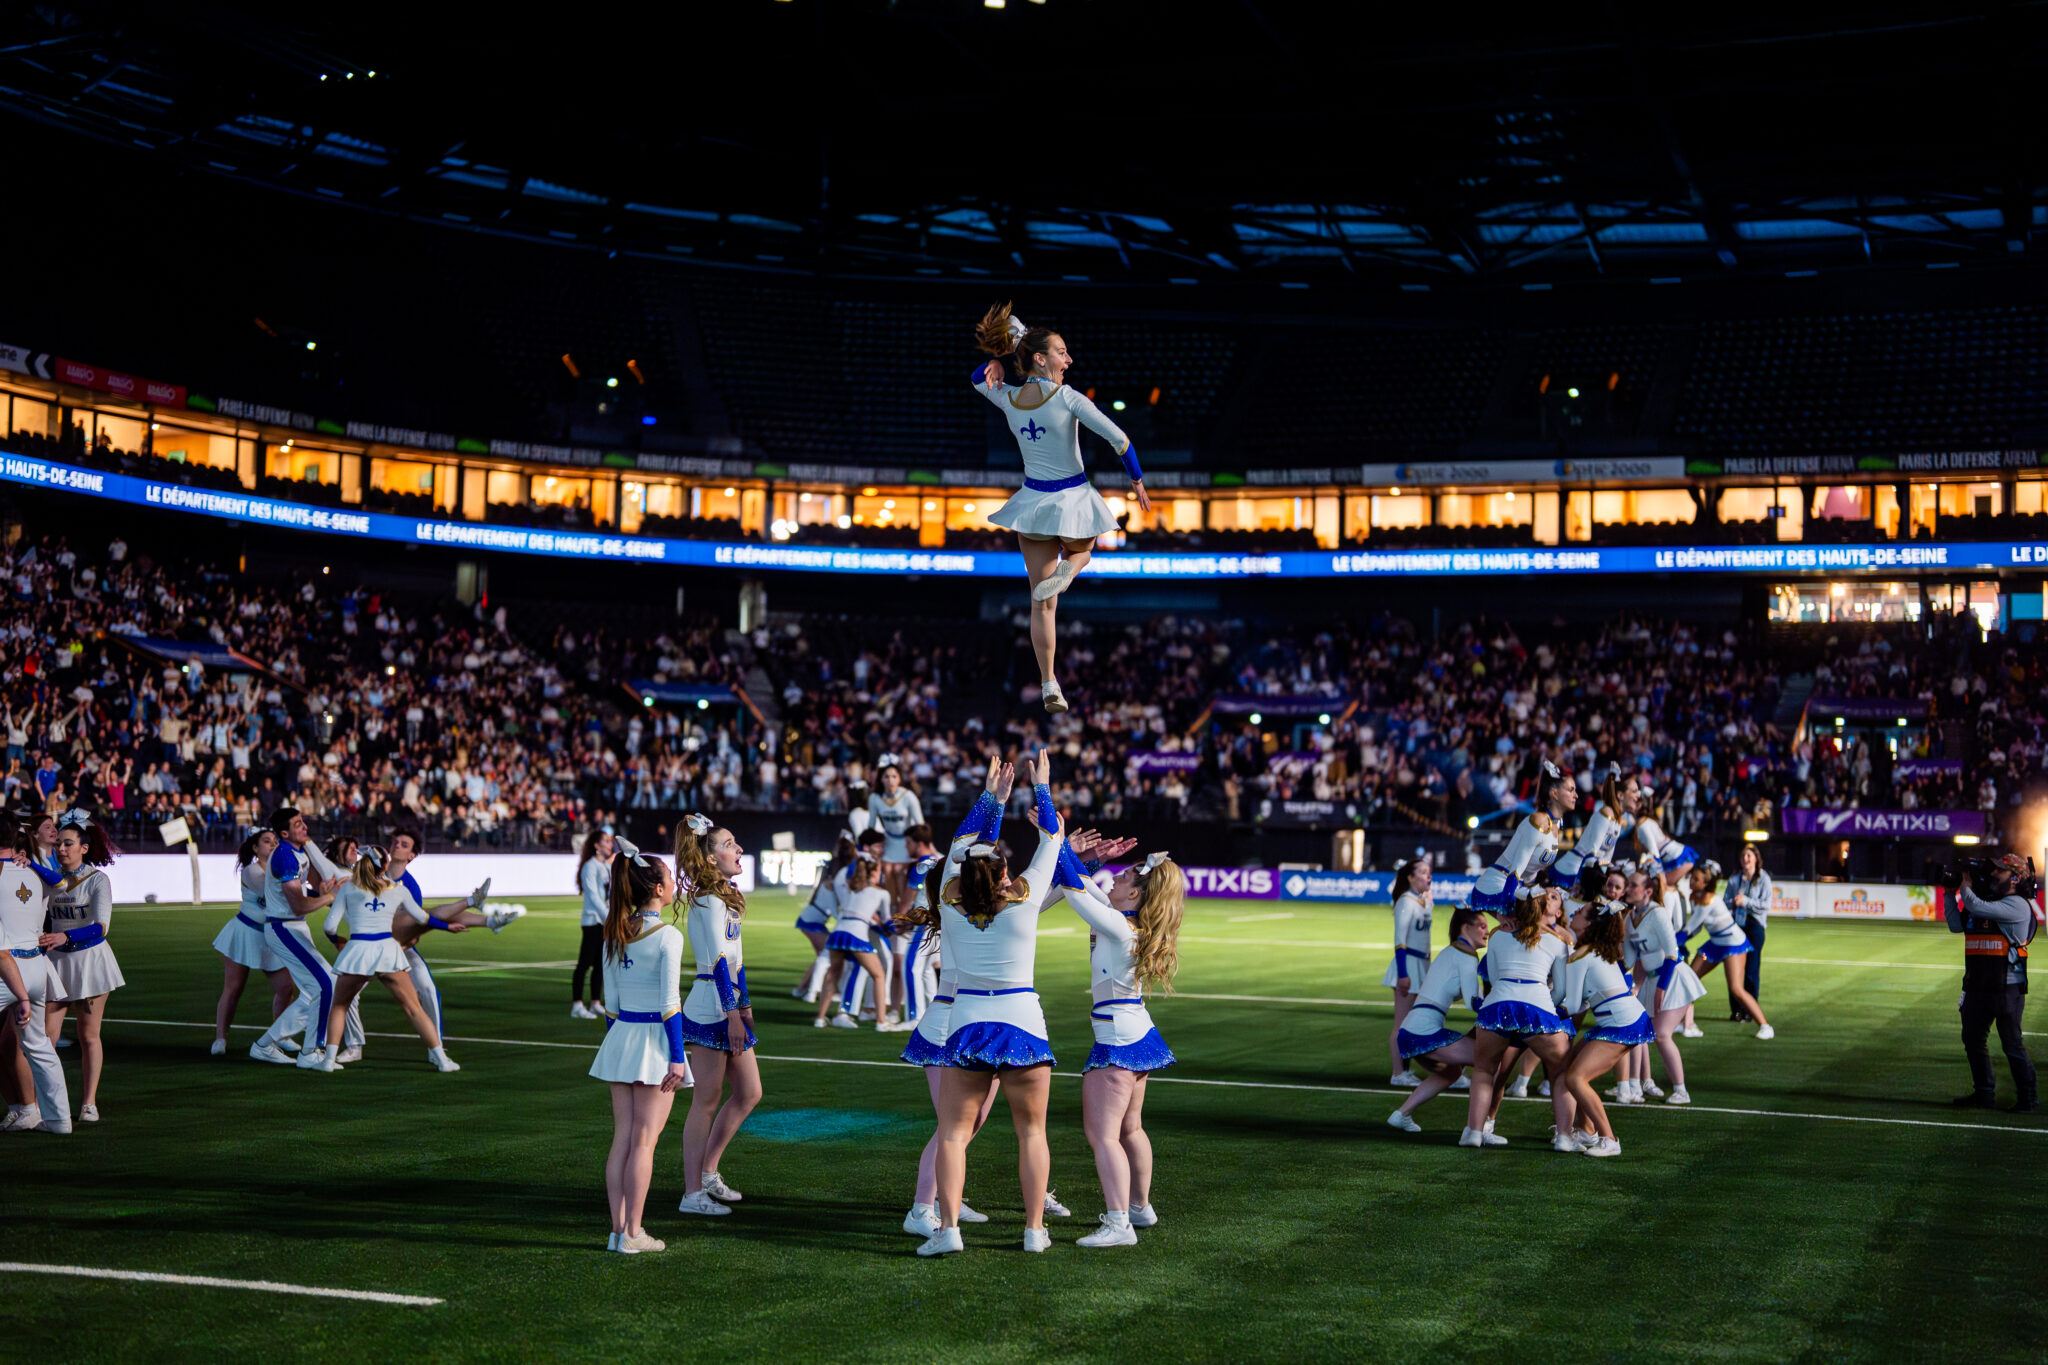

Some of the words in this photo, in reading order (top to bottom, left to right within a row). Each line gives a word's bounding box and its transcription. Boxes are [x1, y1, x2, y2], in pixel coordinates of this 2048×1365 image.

[1724, 456, 1756, 473] PARIS
[1758, 456, 1772, 473] LA
[1773, 456, 1820, 473] DEFENSE
[1898, 453, 1933, 471] PARIS
[1934, 453, 1949, 470] LA
[1951, 451, 2001, 468] DEFENSE
[6, 459, 103, 492] HAUTS-DE-SEINE
[146, 485, 161, 503] LE
[162, 486, 248, 515] DÉPARTEMENT
[249, 501, 272, 520] DES
[273, 505, 369, 533] HAUTS-DE-SEINE
[416, 523, 433, 540] LE
[434, 522, 527, 548] DÉPARTEMENT
[528, 533, 554, 551] DES
[555, 536, 665, 559] HAUTS-DE-SEINE
[715, 547, 732, 563] LE
[733, 545, 832, 567] DÉPARTEMENT
[833, 552, 860, 569] DES
[861, 554, 975, 572] HAUTS-DE-SEINE
[1332, 555, 1350, 572] LE
[1351, 552, 1451, 572] DÉPARTEMENT
[1452, 553, 1482, 571] DES
[1483, 552, 1600, 570] HAUTS-DE-SEINE
[1655, 551, 1674, 568] LE
[1675, 547, 1785, 568] DÉPARTEMENT
[1786, 549, 1817, 567] DES
[1818, 547, 1947, 566] HAUTS-DE-SEINE
[2011, 546, 2031, 563] LE
[1854, 812, 1950, 832] NATIXIS
